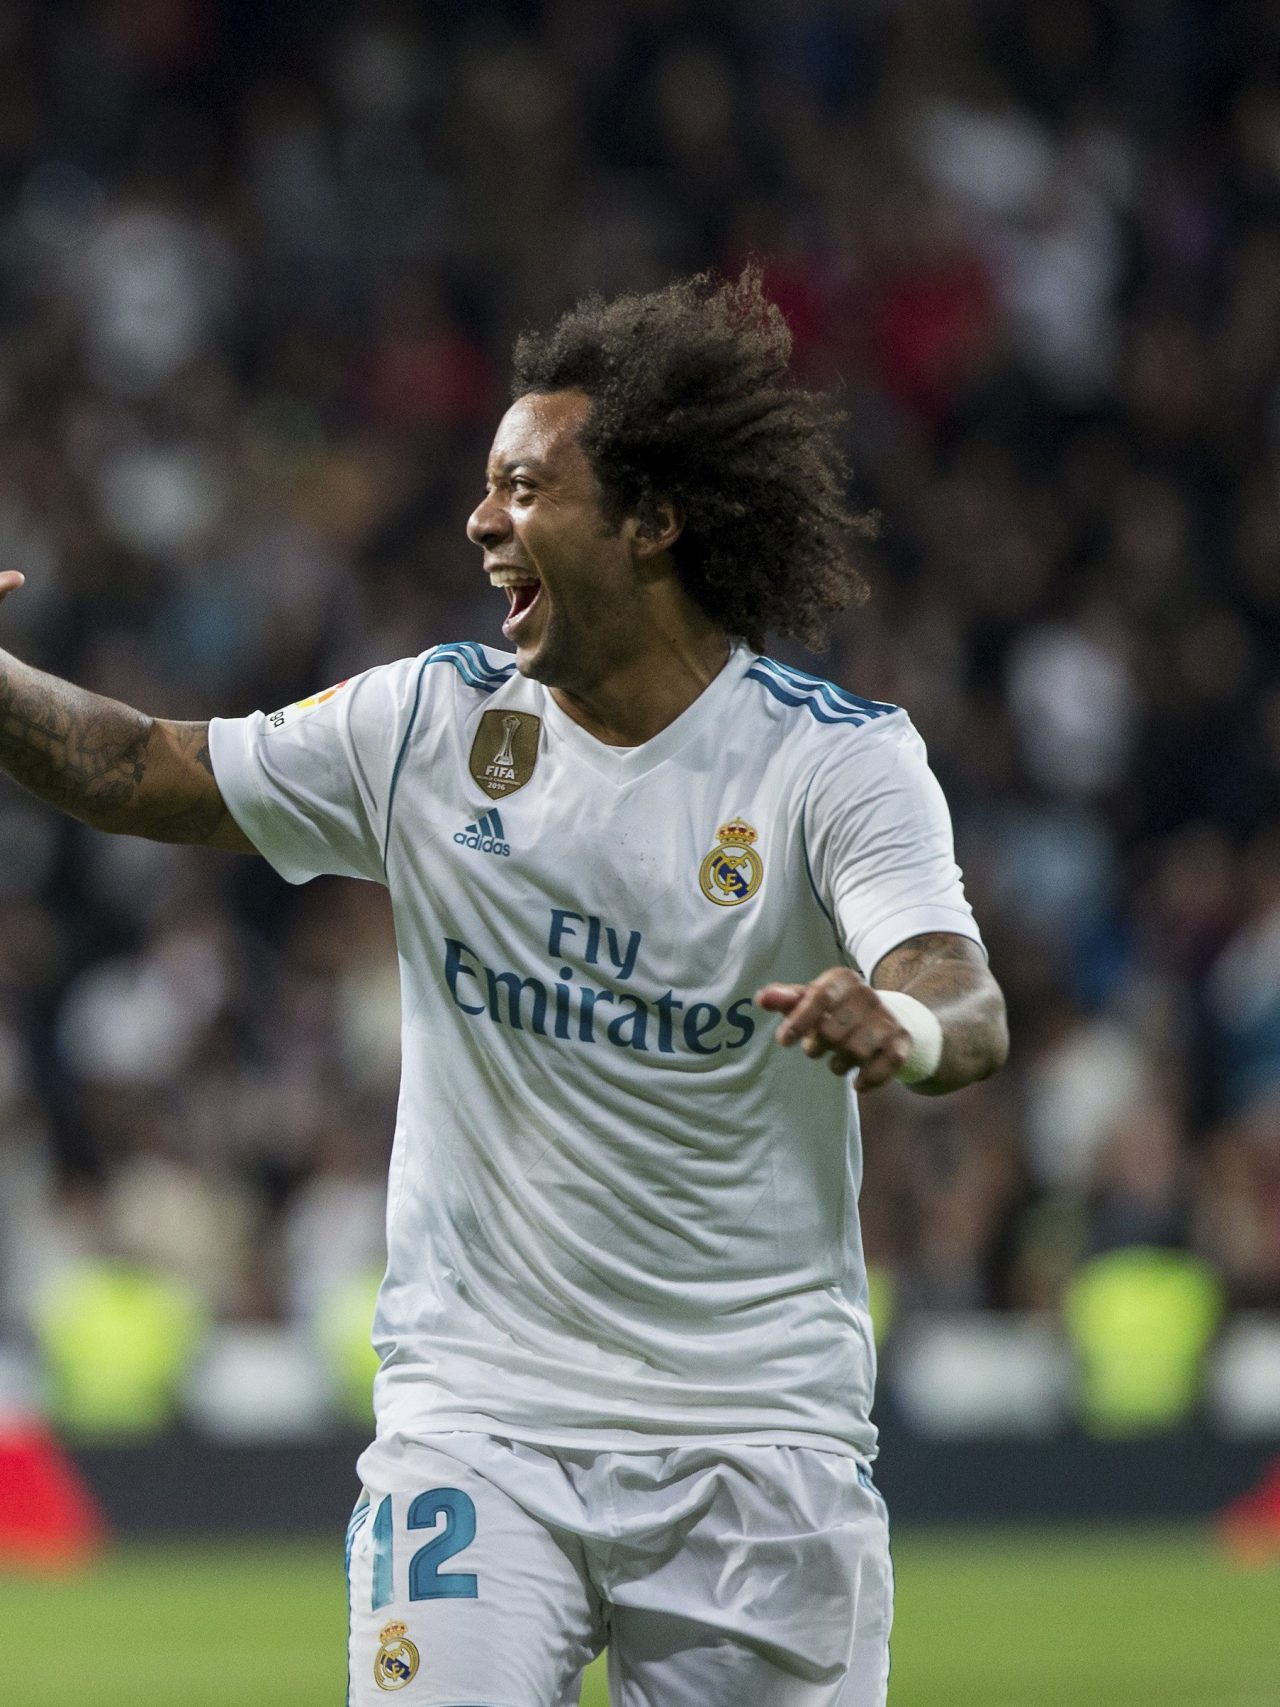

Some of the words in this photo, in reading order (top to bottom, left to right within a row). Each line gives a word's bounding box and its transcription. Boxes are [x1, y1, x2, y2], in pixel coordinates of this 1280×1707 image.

[485, 764, 515, 780] FIFA
[487, 781, 506, 791] 2016
[453, 832, 510, 857] adidas
[548, 909, 641, 979] Fly
[444, 938, 756, 1054] Emirates
[372, 1487, 478, 1611] 12
